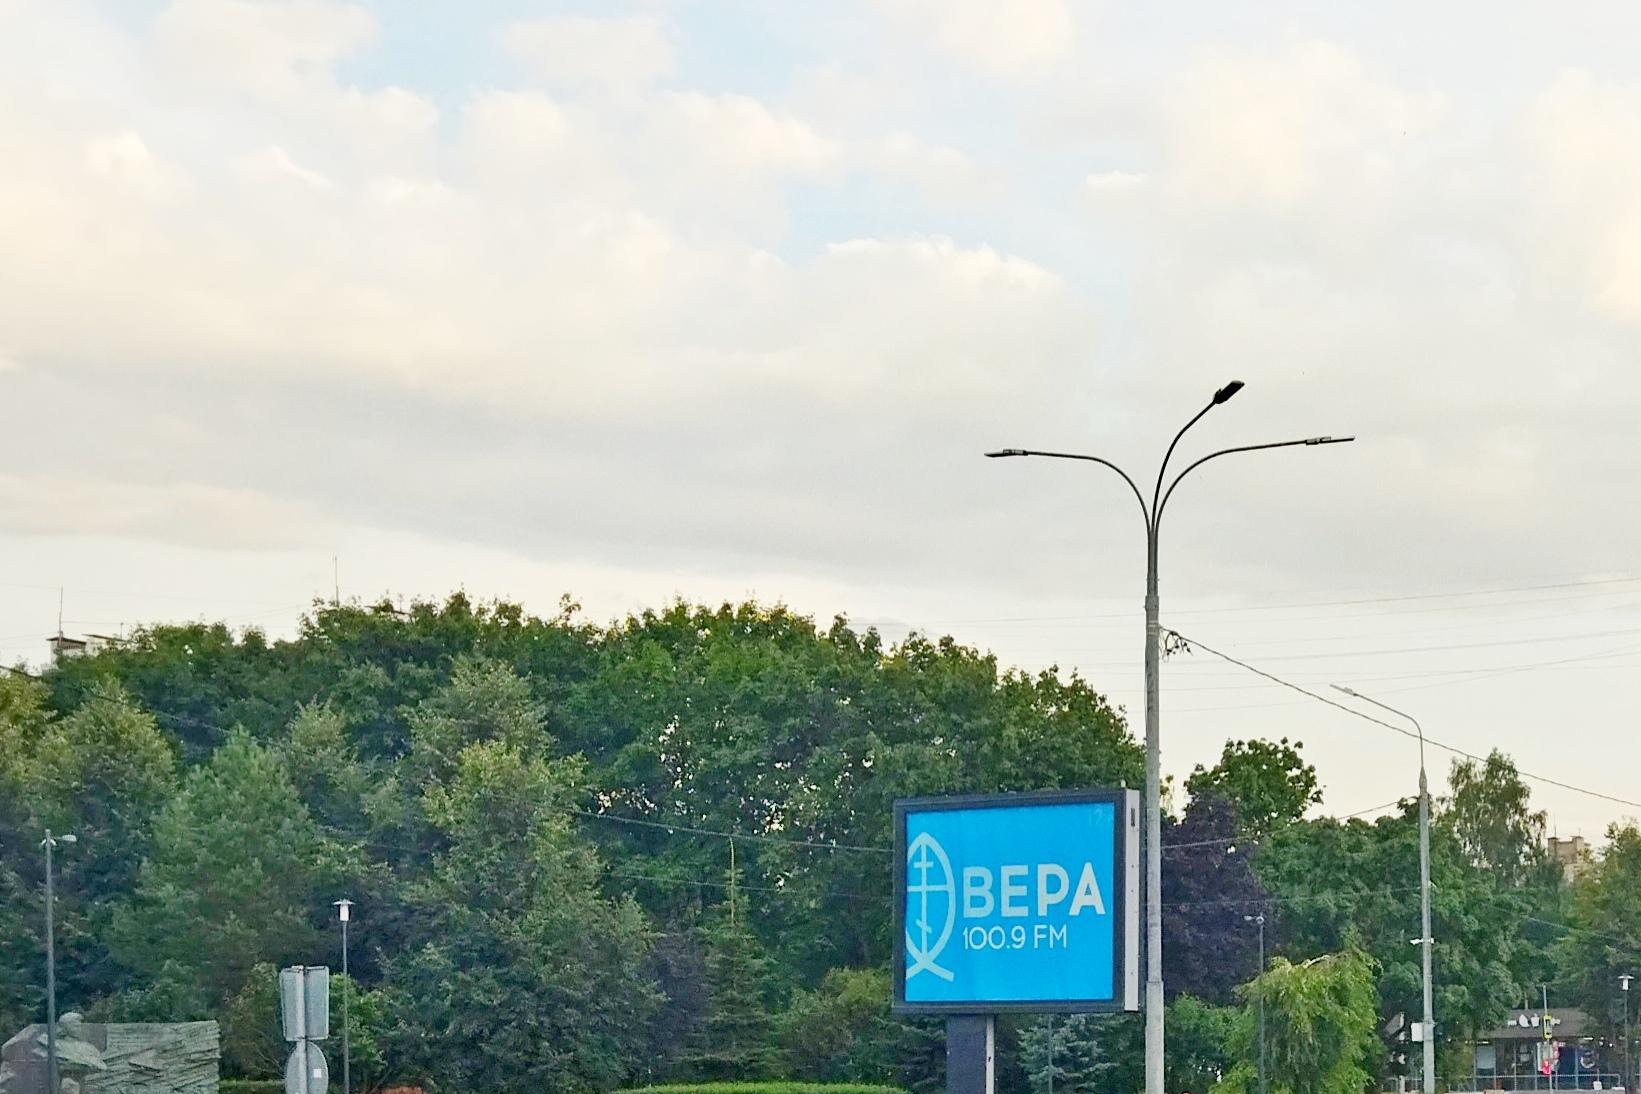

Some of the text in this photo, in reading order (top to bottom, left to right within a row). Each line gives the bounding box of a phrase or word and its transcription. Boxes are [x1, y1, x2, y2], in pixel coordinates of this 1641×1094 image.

[962, 862, 1106, 918] ВЕРА
[963, 924, 1067, 950] 100.9 FM
